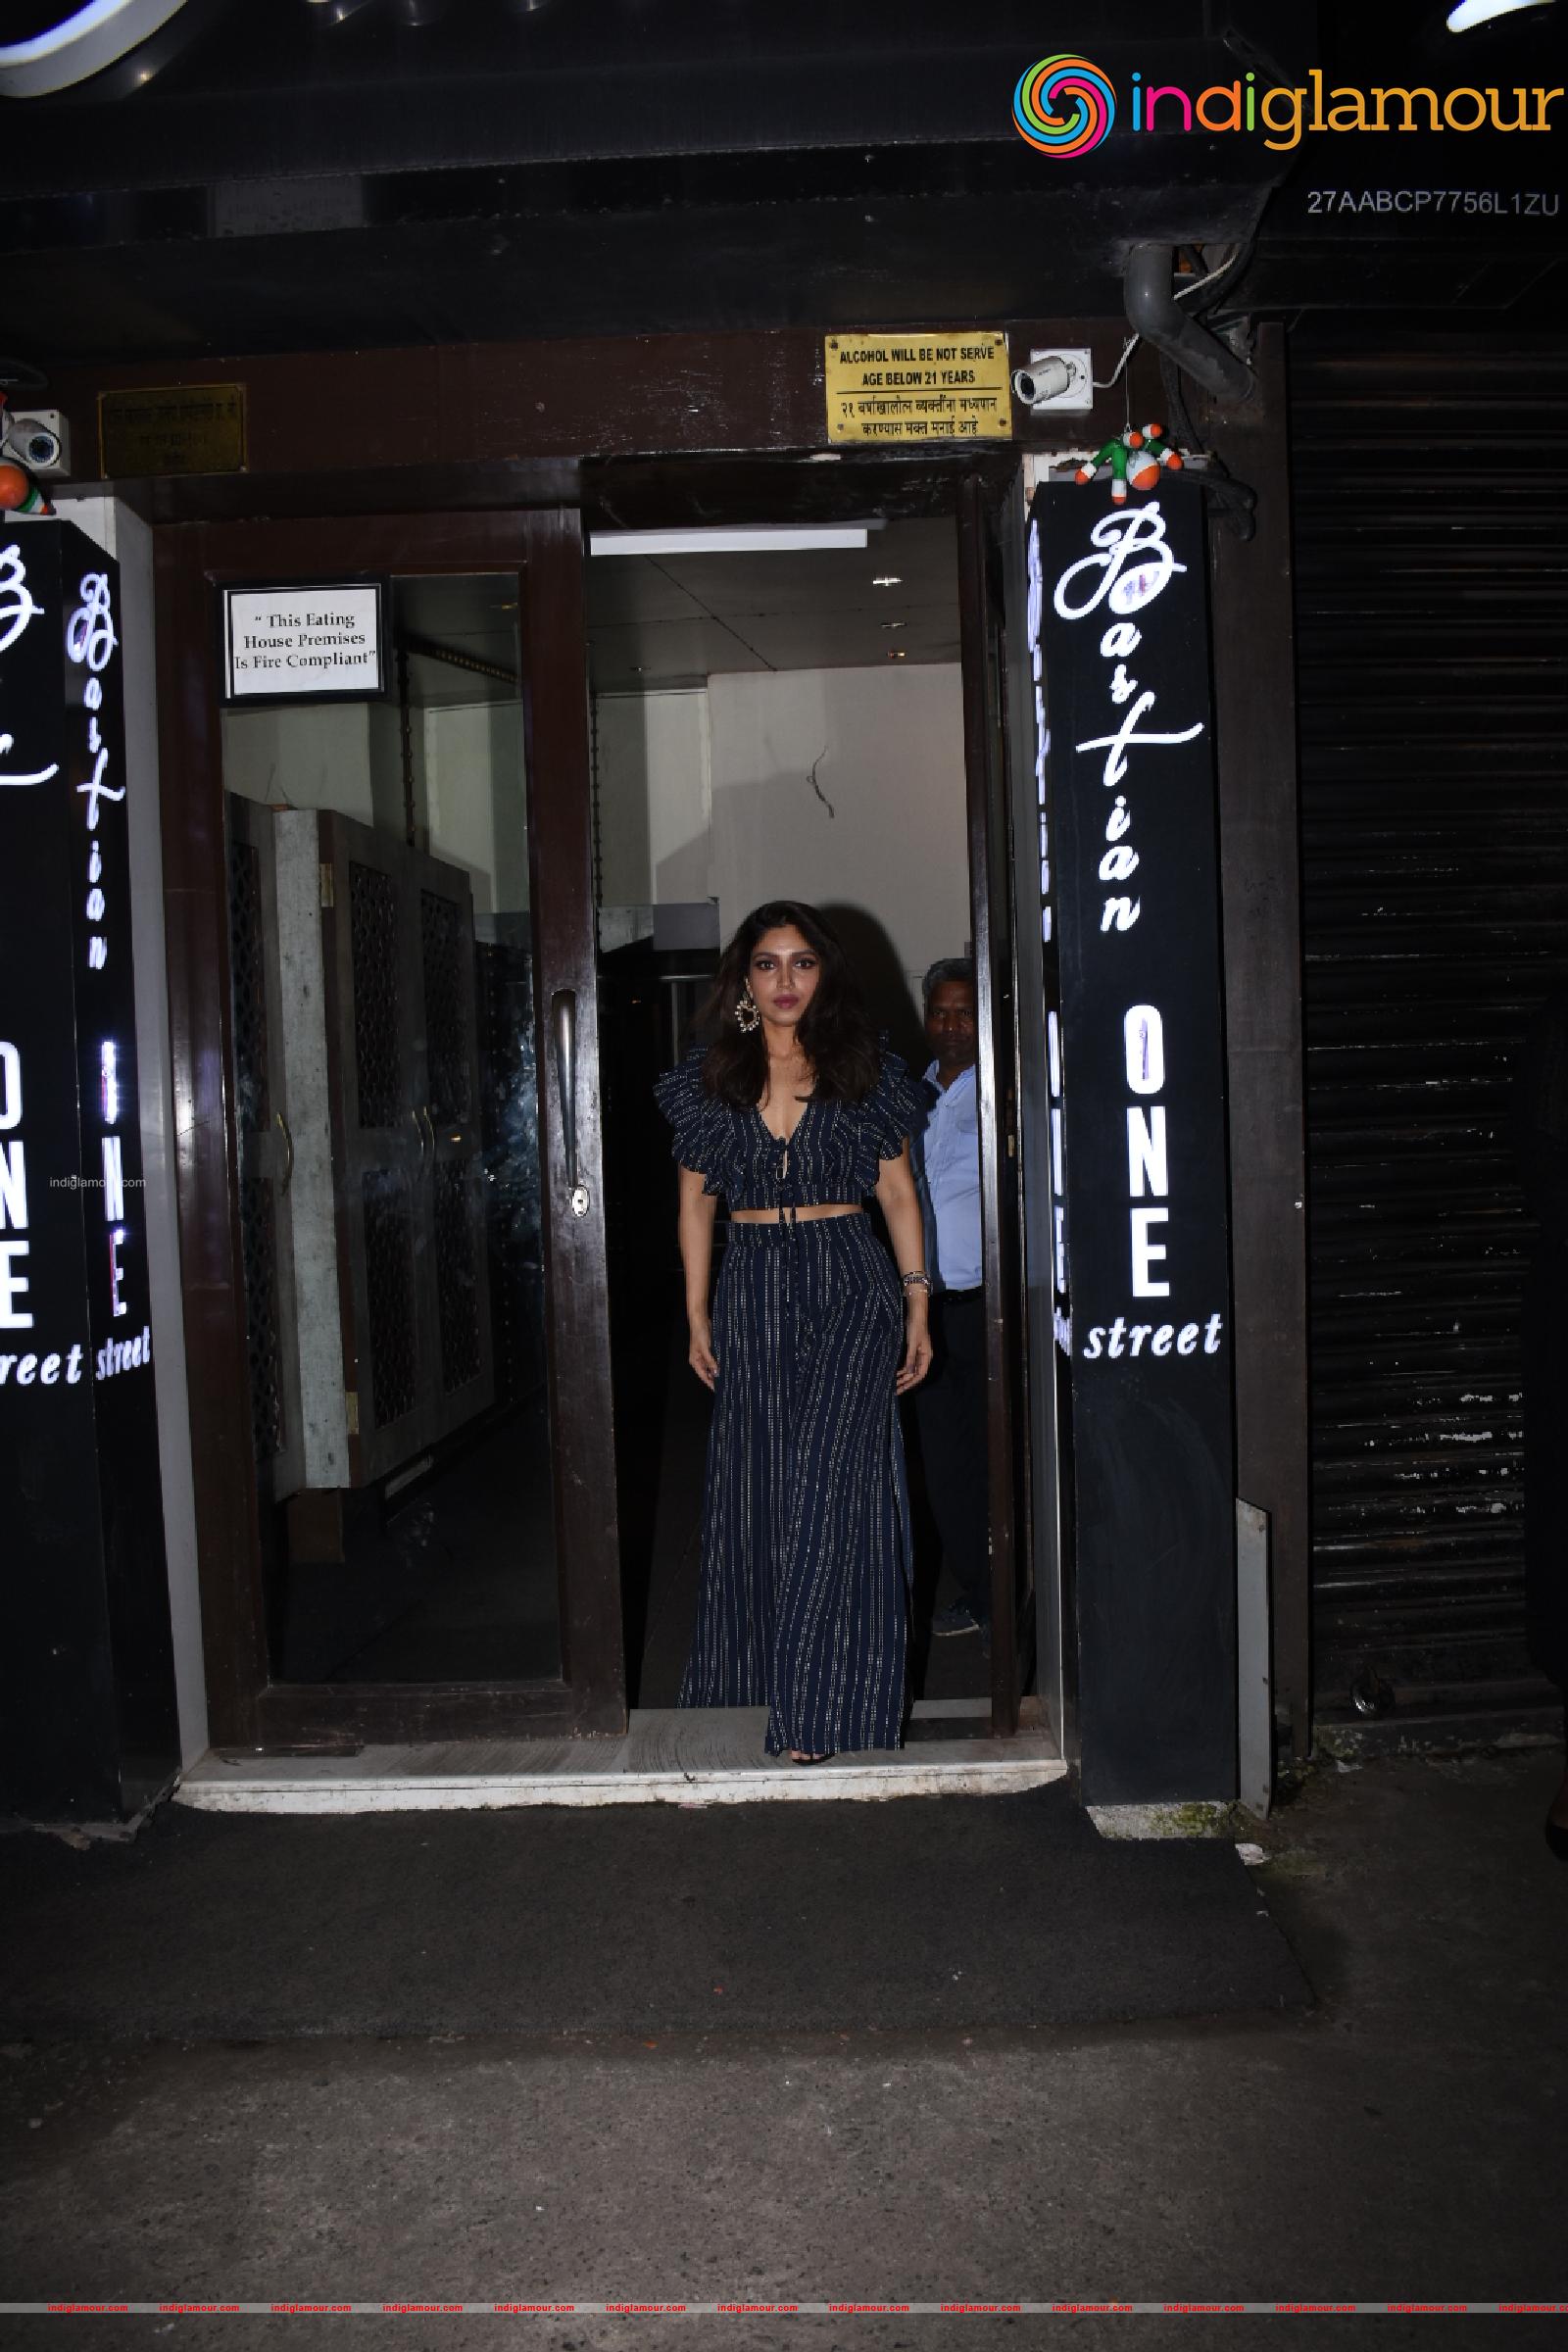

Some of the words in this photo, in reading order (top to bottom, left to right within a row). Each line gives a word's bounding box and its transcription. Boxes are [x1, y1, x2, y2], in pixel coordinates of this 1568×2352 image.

[1307, 190, 1559, 216] 27AABCP7756L1ZU
[840, 348, 888, 364] ALCOHOL
[891, 348, 916, 362] WILL
[919, 348, 933, 361] BE
[937, 348, 956, 361] NOT
[960, 346, 994, 360] SERVE
[862, 372, 883, 385] AGE
[886, 371, 921, 385] BELOW
[925, 370, 937, 384] 21
[942, 369, 975, 383] YEARS
[267, 613, 301, 627] This
[307, 612, 355, 628] Eating
[244, 635, 293, 649] House
[298, 632, 366, 648] Premises
[234, 656, 248, 669] Is
[253, 656, 281, 668] Fire
[1123, 1004, 1170, 1298] ONE
[1083, 1313, 1223, 1359] street
[96, 1325, 151, 1381] street
[0, 1344, 83, 1386] reet
